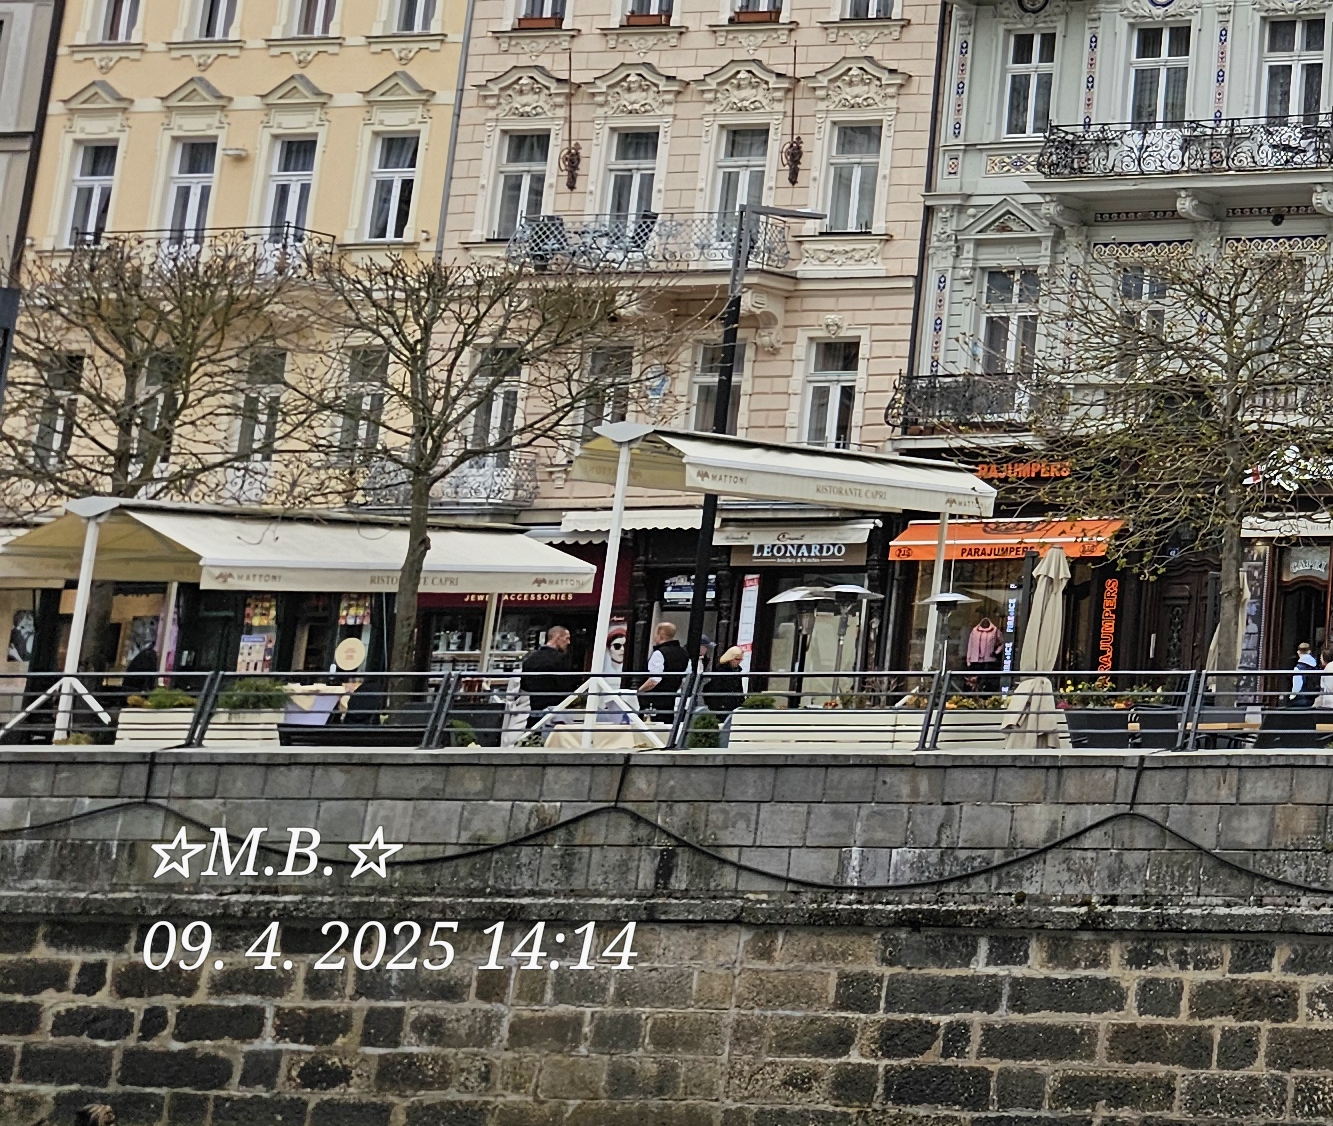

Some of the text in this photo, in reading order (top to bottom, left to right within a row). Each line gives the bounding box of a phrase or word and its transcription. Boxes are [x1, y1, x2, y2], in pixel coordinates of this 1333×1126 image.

[815, 484, 887, 500] RISTORANTE CAPRI
[752, 543, 846, 557] LEONARDO
[431, 577, 459, 586] CAPRI
[502, 593, 573, 601] ACCESSORIES
